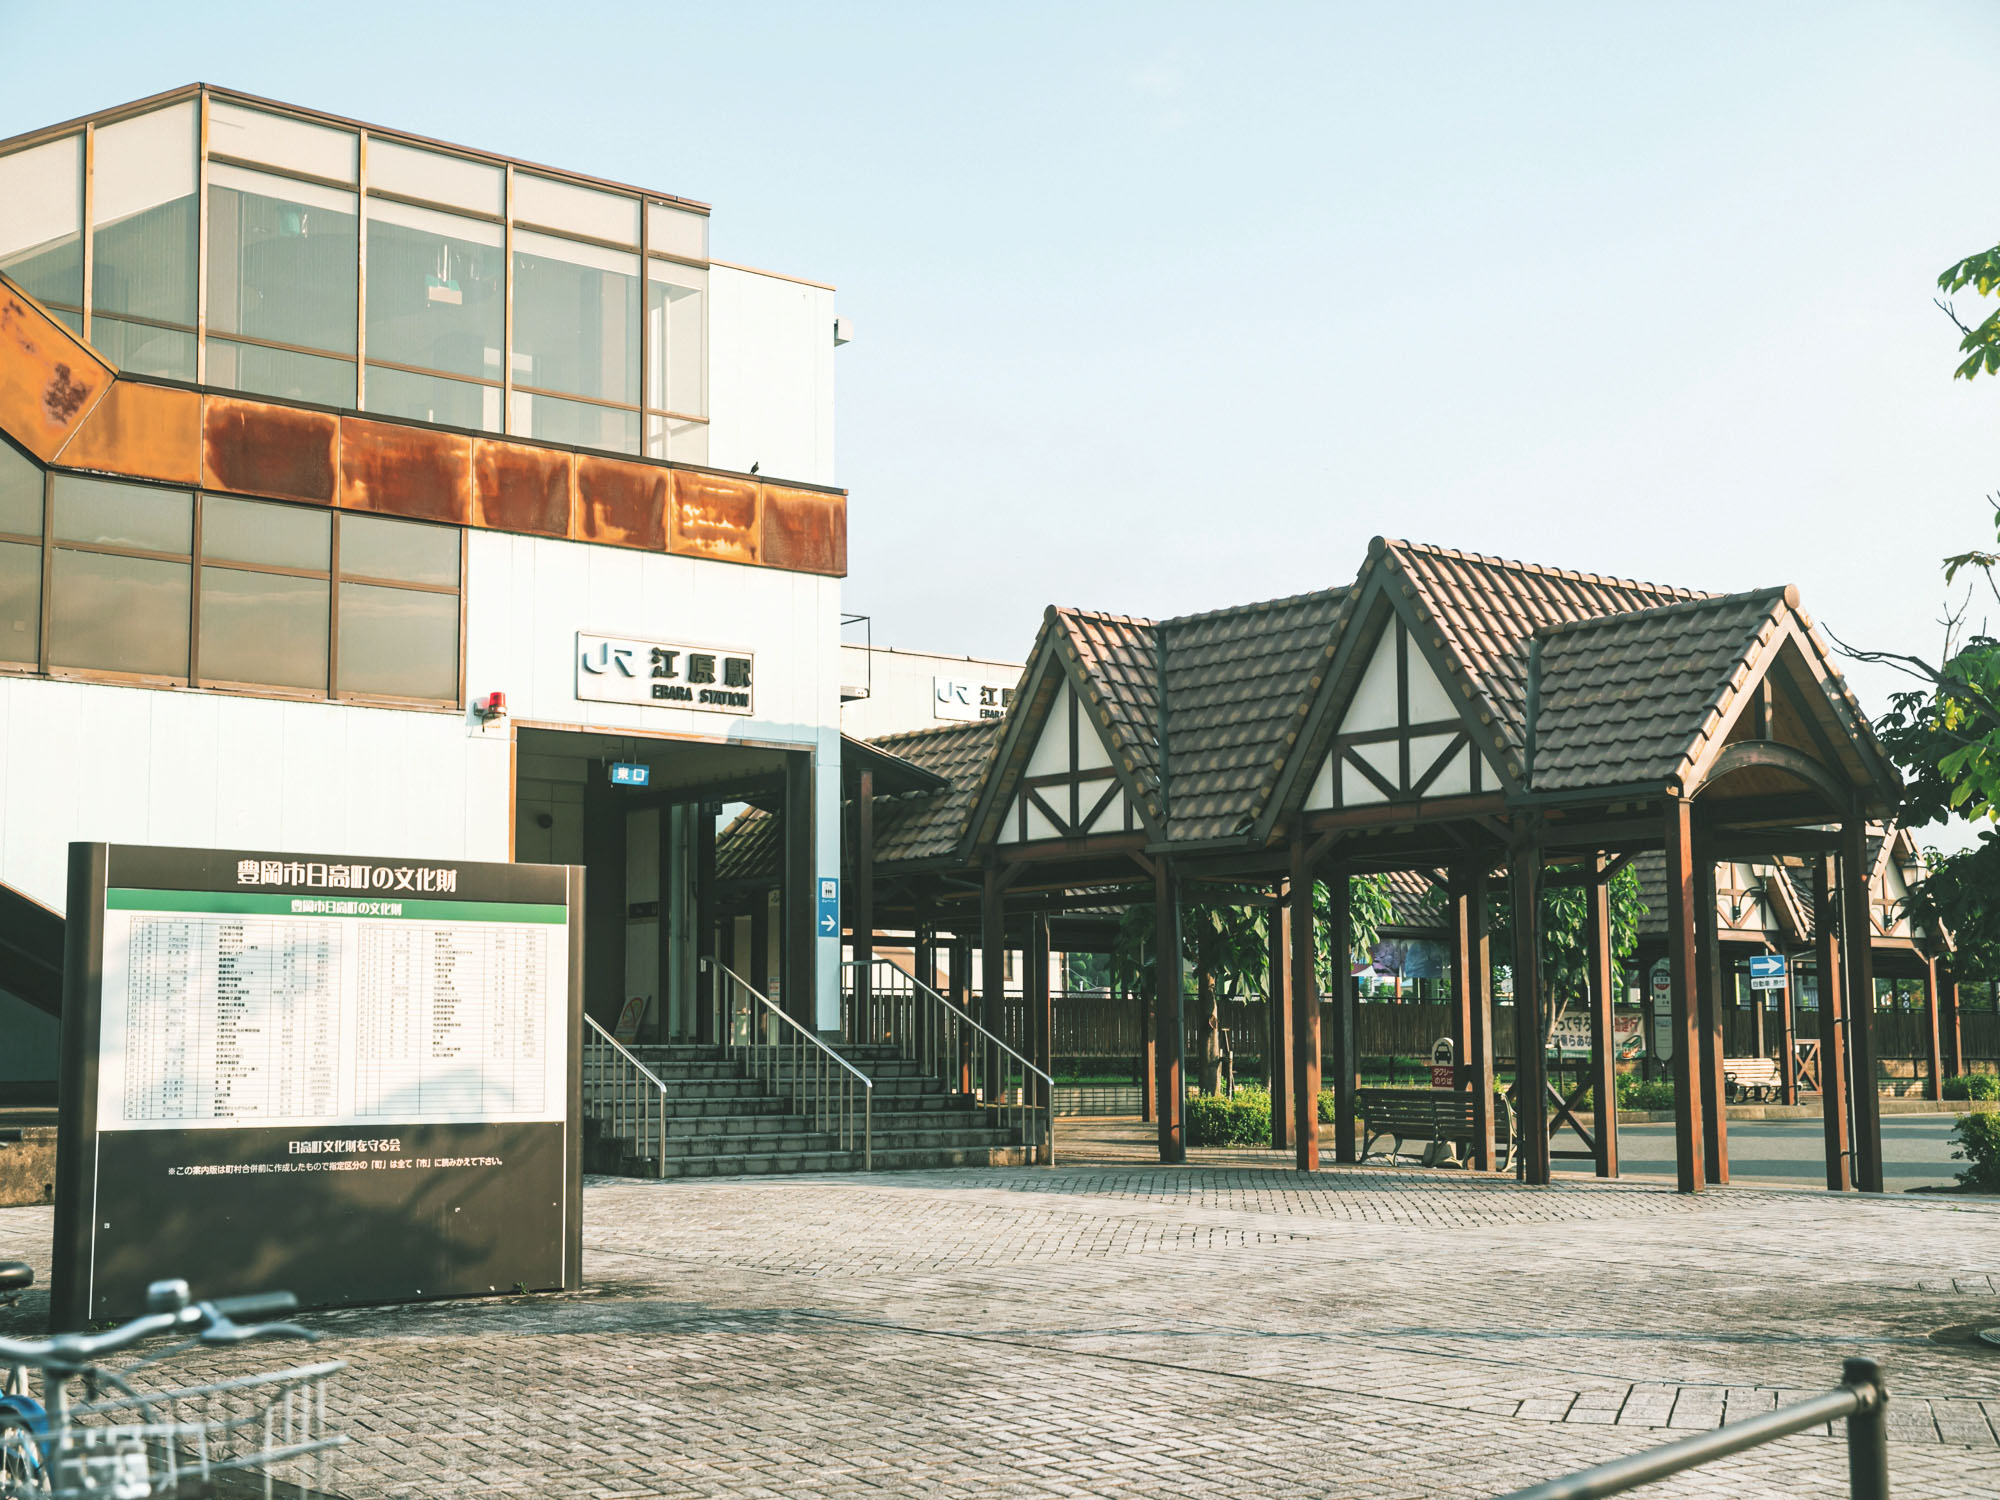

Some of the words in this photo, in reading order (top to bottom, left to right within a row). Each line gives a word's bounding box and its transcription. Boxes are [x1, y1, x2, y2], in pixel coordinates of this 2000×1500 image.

[583, 641, 637, 678] JR
[651, 646, 752, 688] 江原駅
[652, 684, 693, 701] EBARA
[699, 689, 749, 707] STATION
[617, 767, 645, 782] 東口
[237, 860, 457, 892] 豊岡市日高町の文化財
[291, 899, 402, 916] 豊岡市日高町の文化財
[1434, 1068, 1453, 1076] タクシー
[1434, 1077, 1452, 1085] のりば
[288, 1138, 400, 1154] 日高町文化財を守る会
